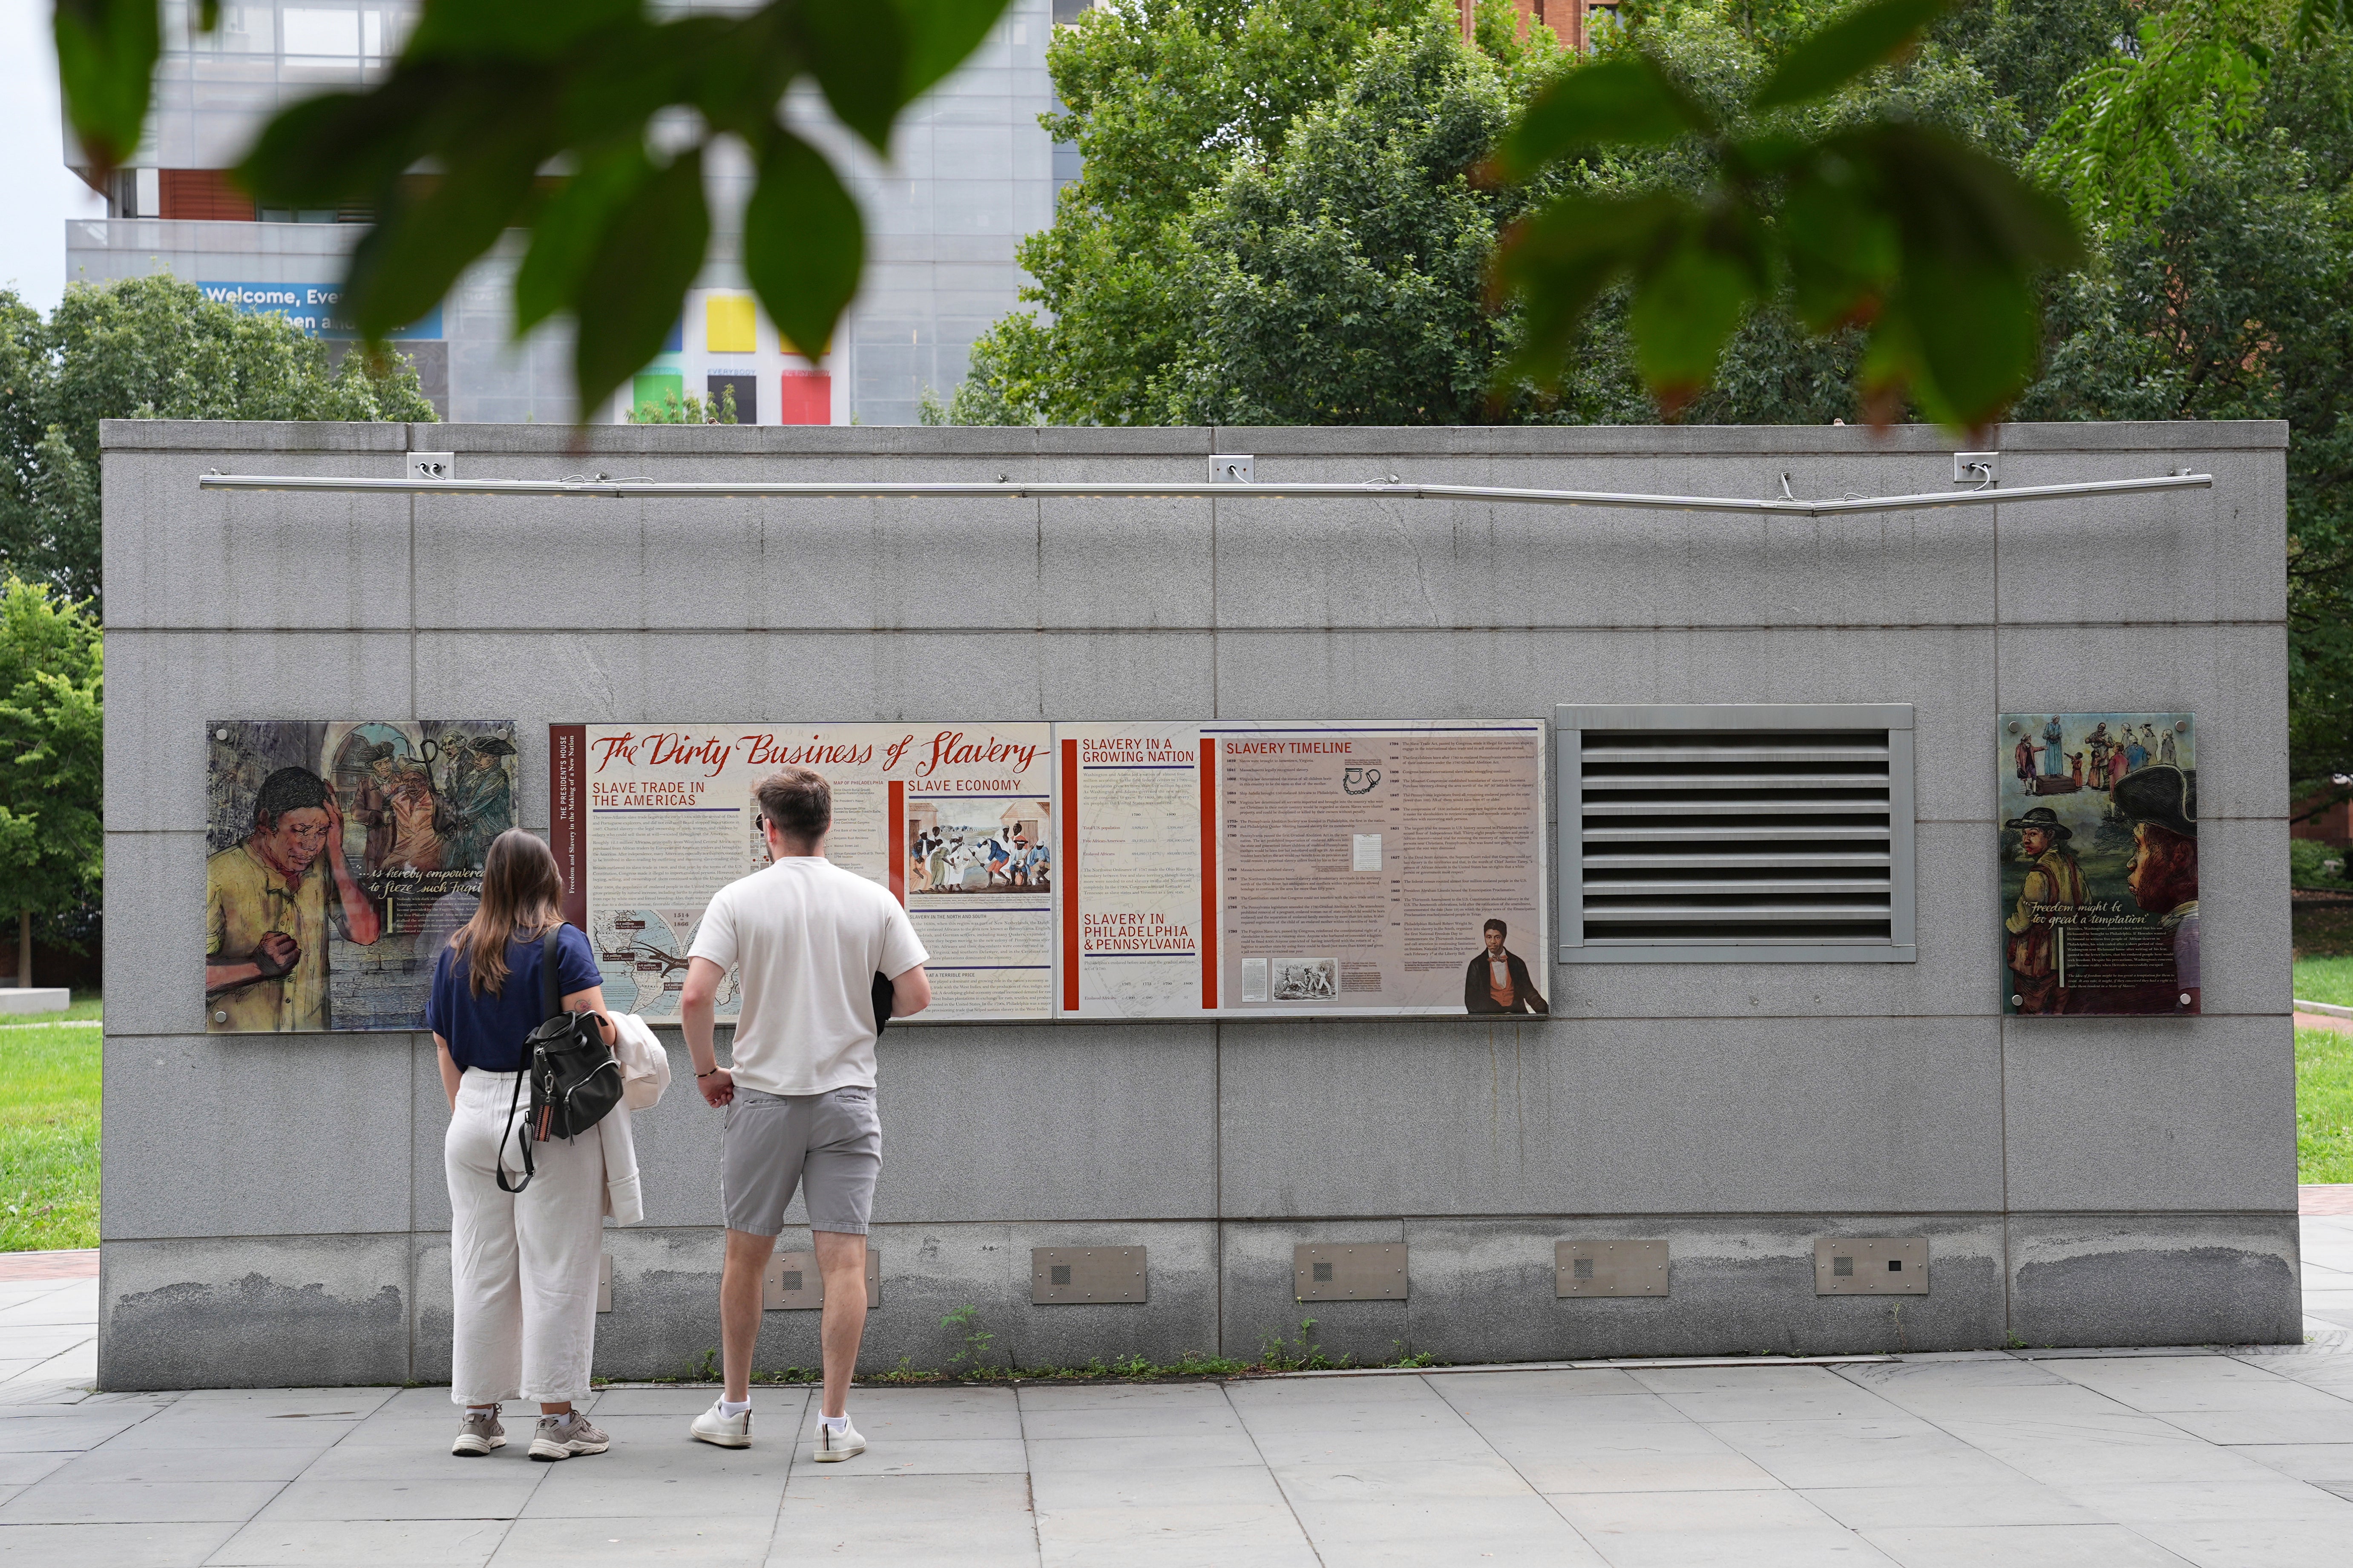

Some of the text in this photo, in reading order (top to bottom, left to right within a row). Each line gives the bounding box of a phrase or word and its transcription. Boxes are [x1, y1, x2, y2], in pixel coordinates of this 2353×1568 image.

[206, 286, 300, 307] Welcome,
[1083, 739, 1171, 750] SLAVERY IN A
[1227, 743, 1352, 754] SLAVERY TIMELINE
[591, 731, 1050, 777] The Dirty Business of Slavery
[1083, 751, 1193, 762] GROWING NATION
[593, 782, 704, 793] SLAVE TRADE IN
[909, 780, 1020, 791] SLAVE ECONOMY
[593, 795, 695, 806] THE AMERICAS
[385, 866, 423, 884] hereby
[368, 882, 382, 891] to
[417, 881, 447, 893] such
[2023, 900, 2123, 917] "Freedom might be
[1084, 914, 1163, 925] SLAVERY IN
[2031, 913, 2046, 923] too
[2048, 913, 2078, 930] great
[1085, 926, 1188, 937] PHILADELPHIA
[1084, 939, 1195, 950] & PENNSYLVANIA
